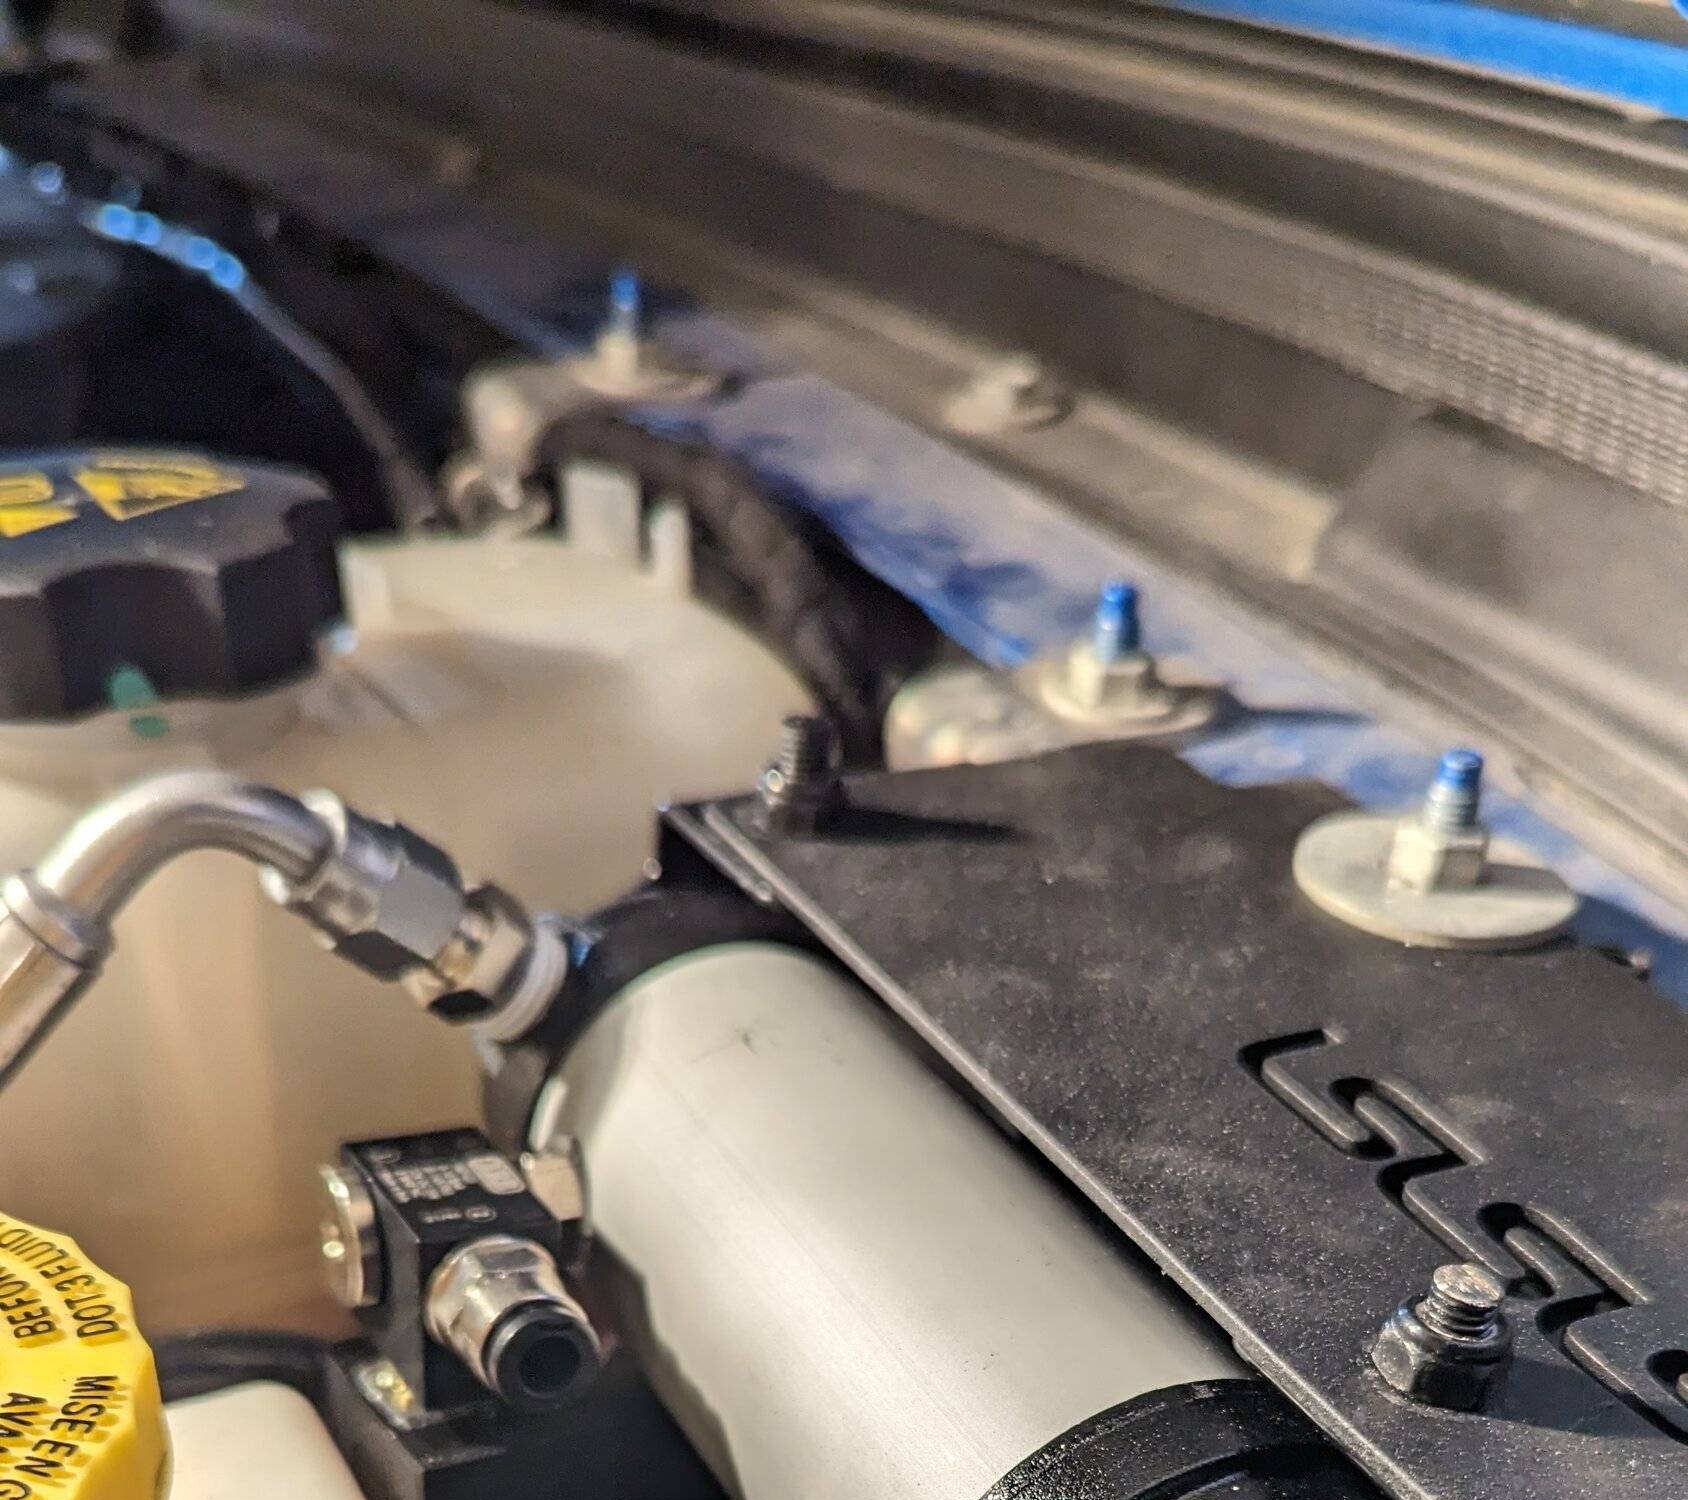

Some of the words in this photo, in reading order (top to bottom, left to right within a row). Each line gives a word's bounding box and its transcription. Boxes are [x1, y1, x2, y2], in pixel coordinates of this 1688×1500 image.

[0, 1228, 82, 1279] FLUID
[54, 1274, 97, 1292] 3
[64, 1293, 120, 1338] DOT
[50, 1375, 119, 1434] MISE
[14, 1439, 79, 1477] EN
